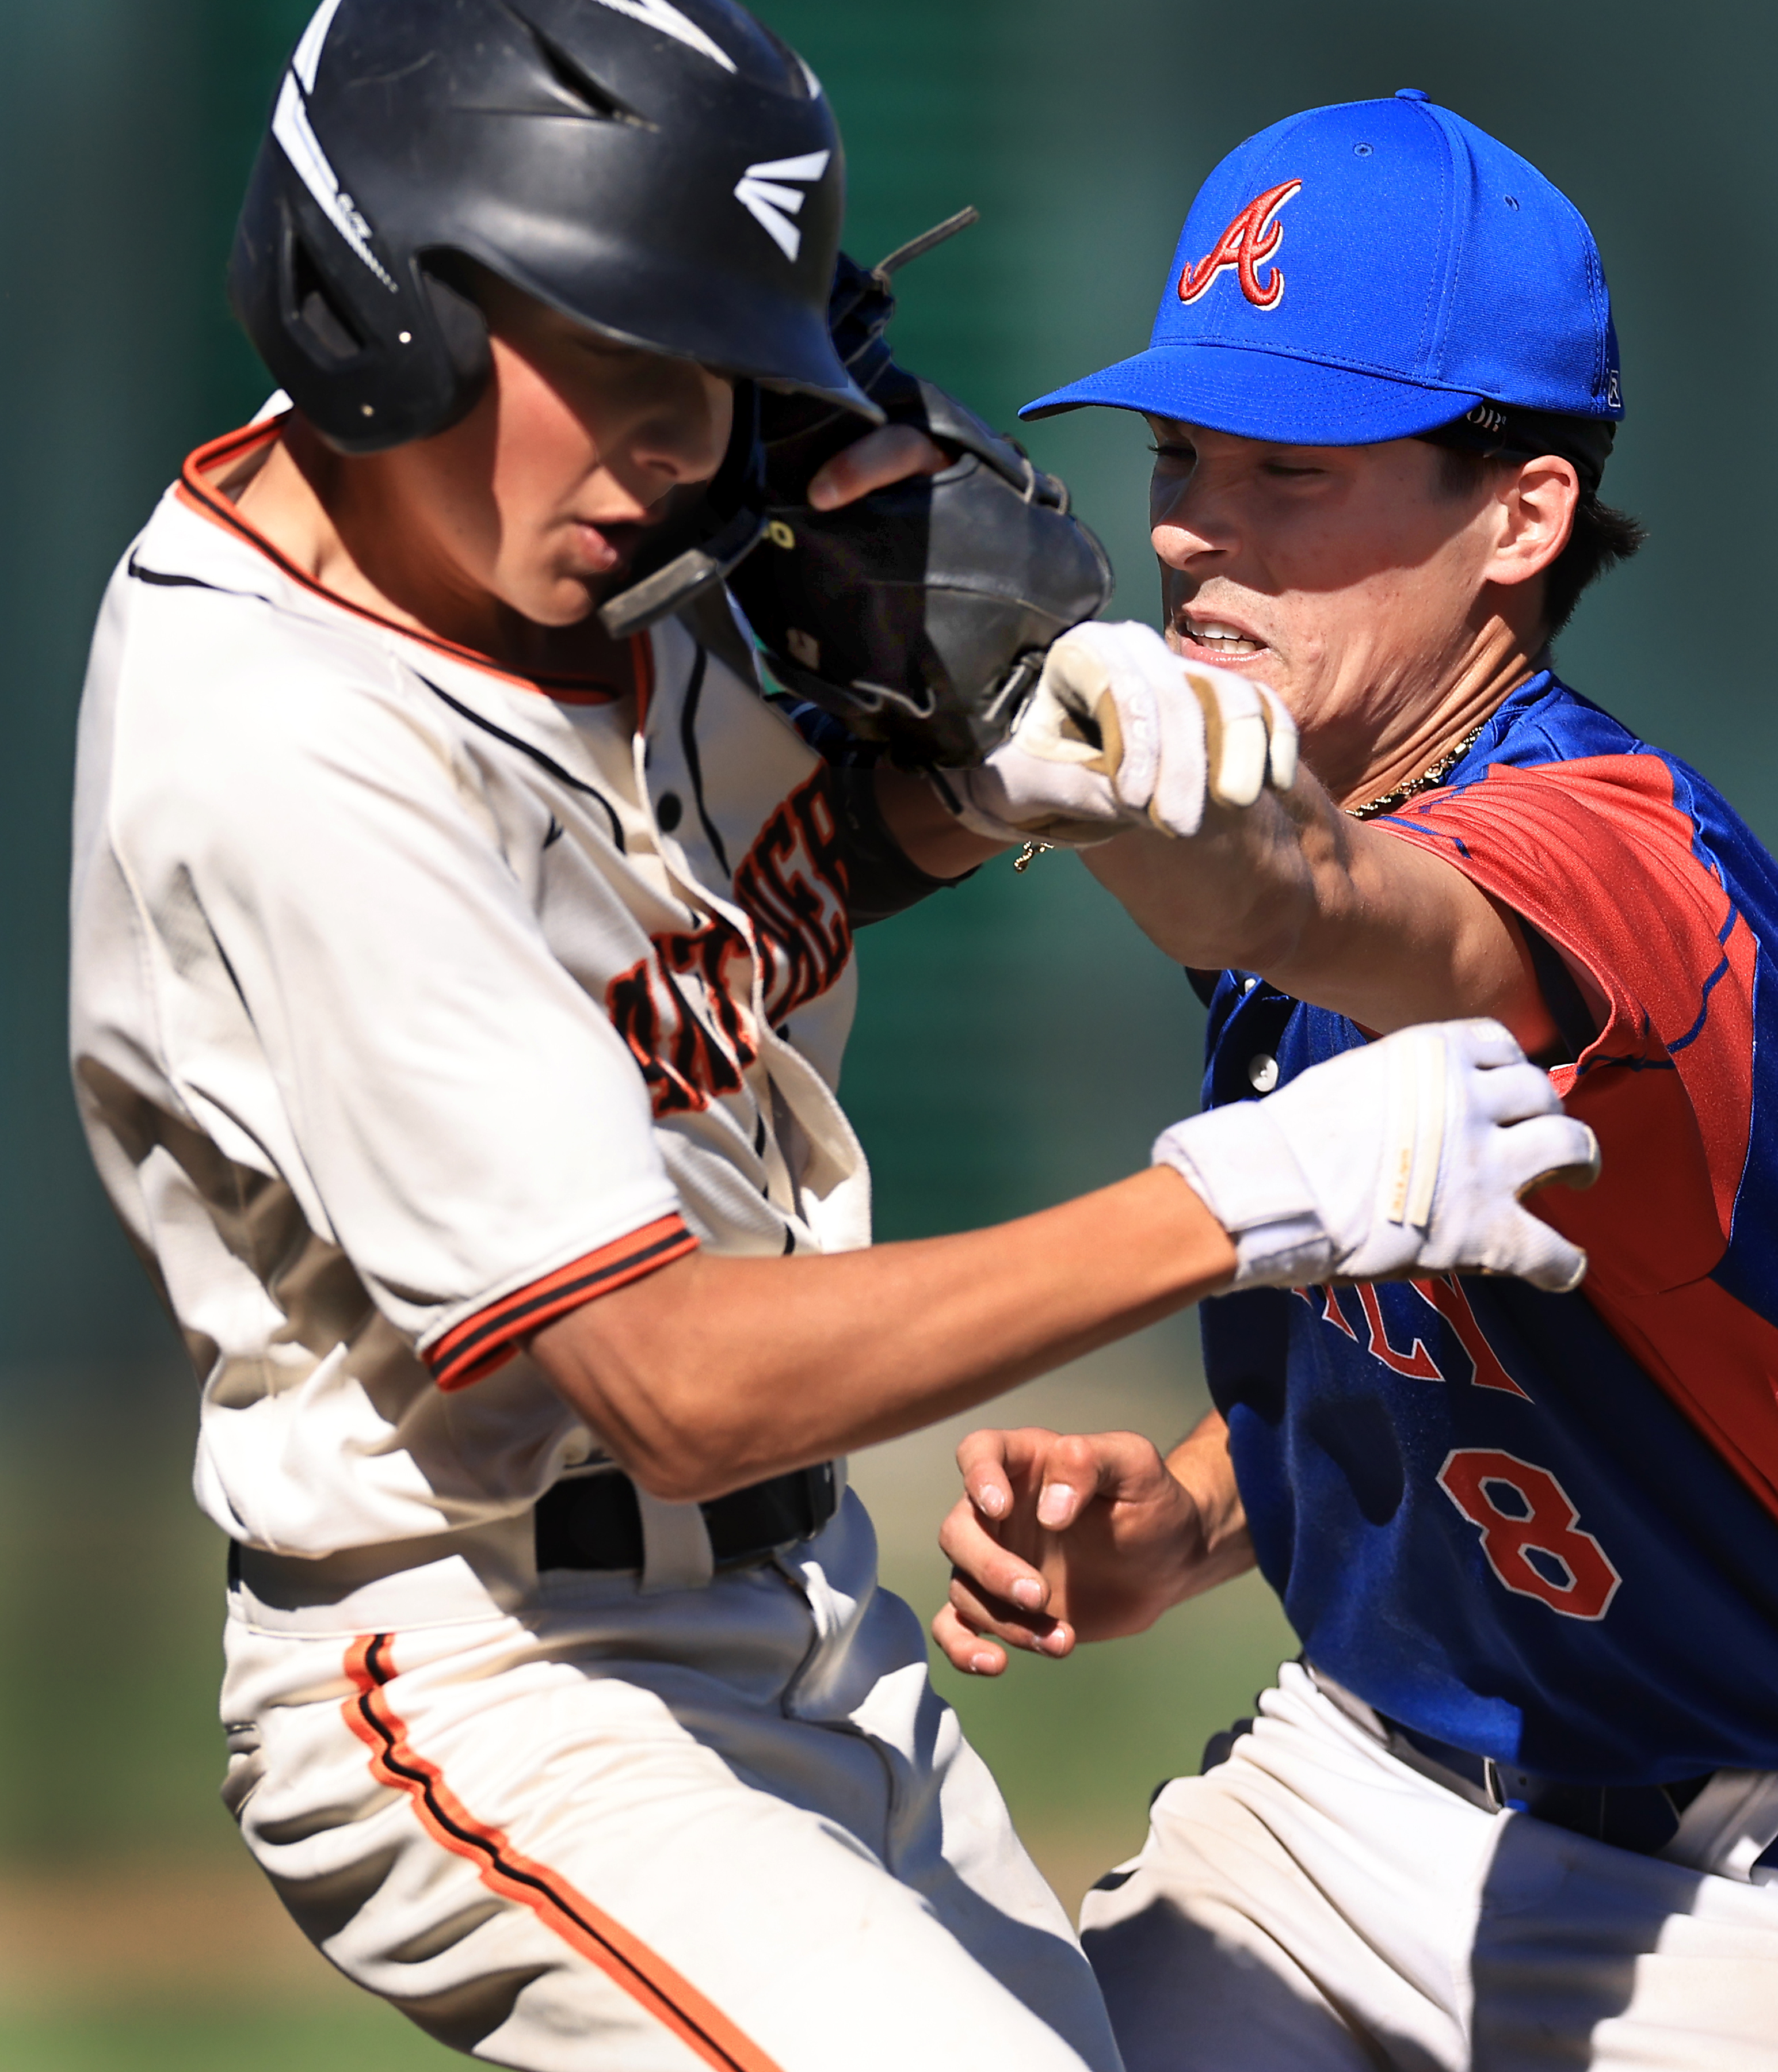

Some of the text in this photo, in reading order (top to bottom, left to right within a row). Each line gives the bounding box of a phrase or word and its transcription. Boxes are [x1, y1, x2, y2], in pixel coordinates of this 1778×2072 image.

[1177, 178, 1303, 311] A
[1291, 1269, 1536, 1406] LY
[1434, 1447, 1623, 1621] 8
